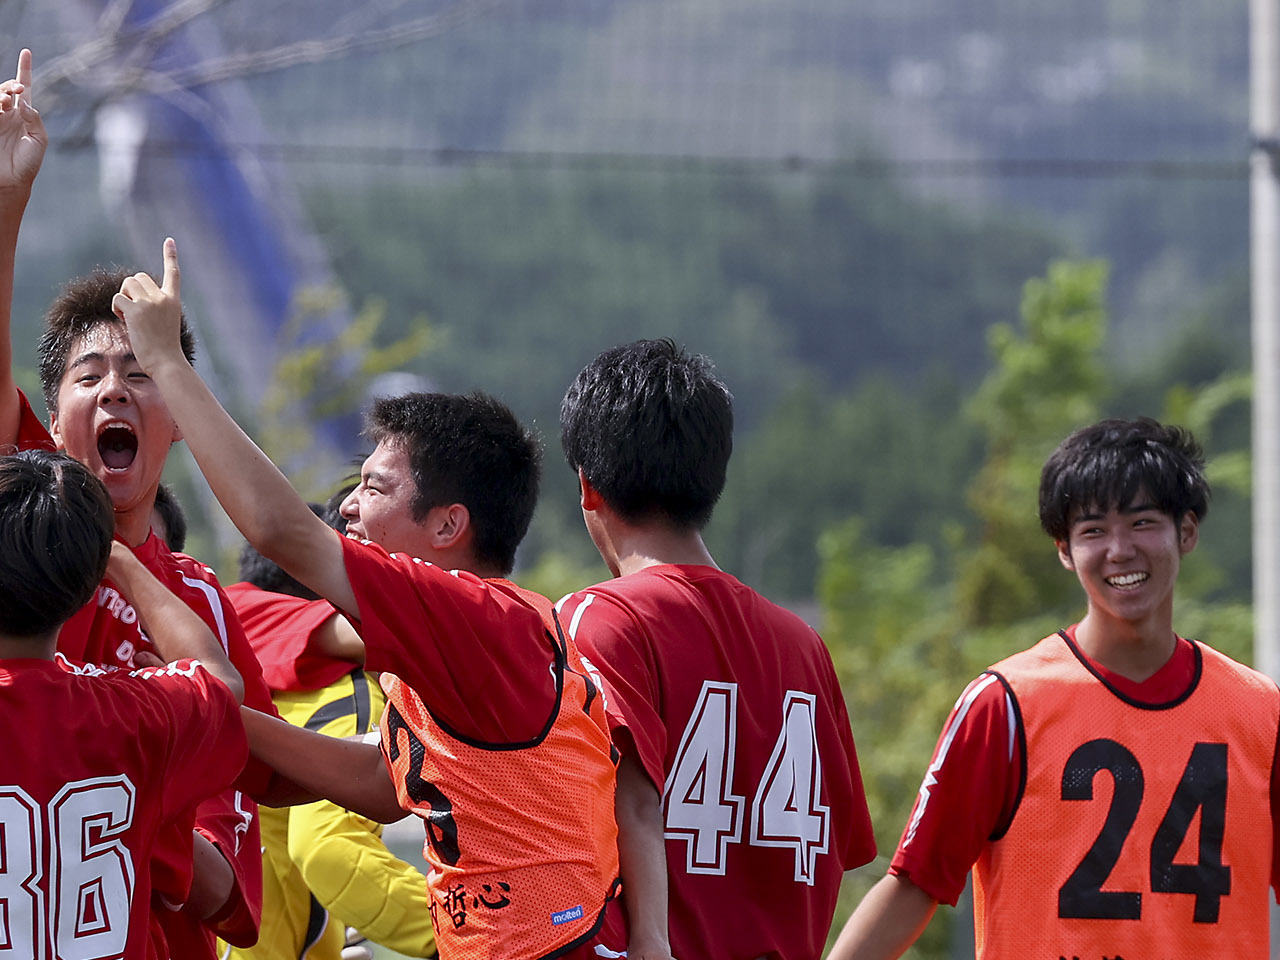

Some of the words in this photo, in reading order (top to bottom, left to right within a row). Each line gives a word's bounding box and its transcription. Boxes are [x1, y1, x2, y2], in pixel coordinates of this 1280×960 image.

[663, 680, 830, 886] 44
[1057, 738, 1231, 923] 24
[443, 882, 510, 928] 哲心
[553, 906, 582, 923] molten
